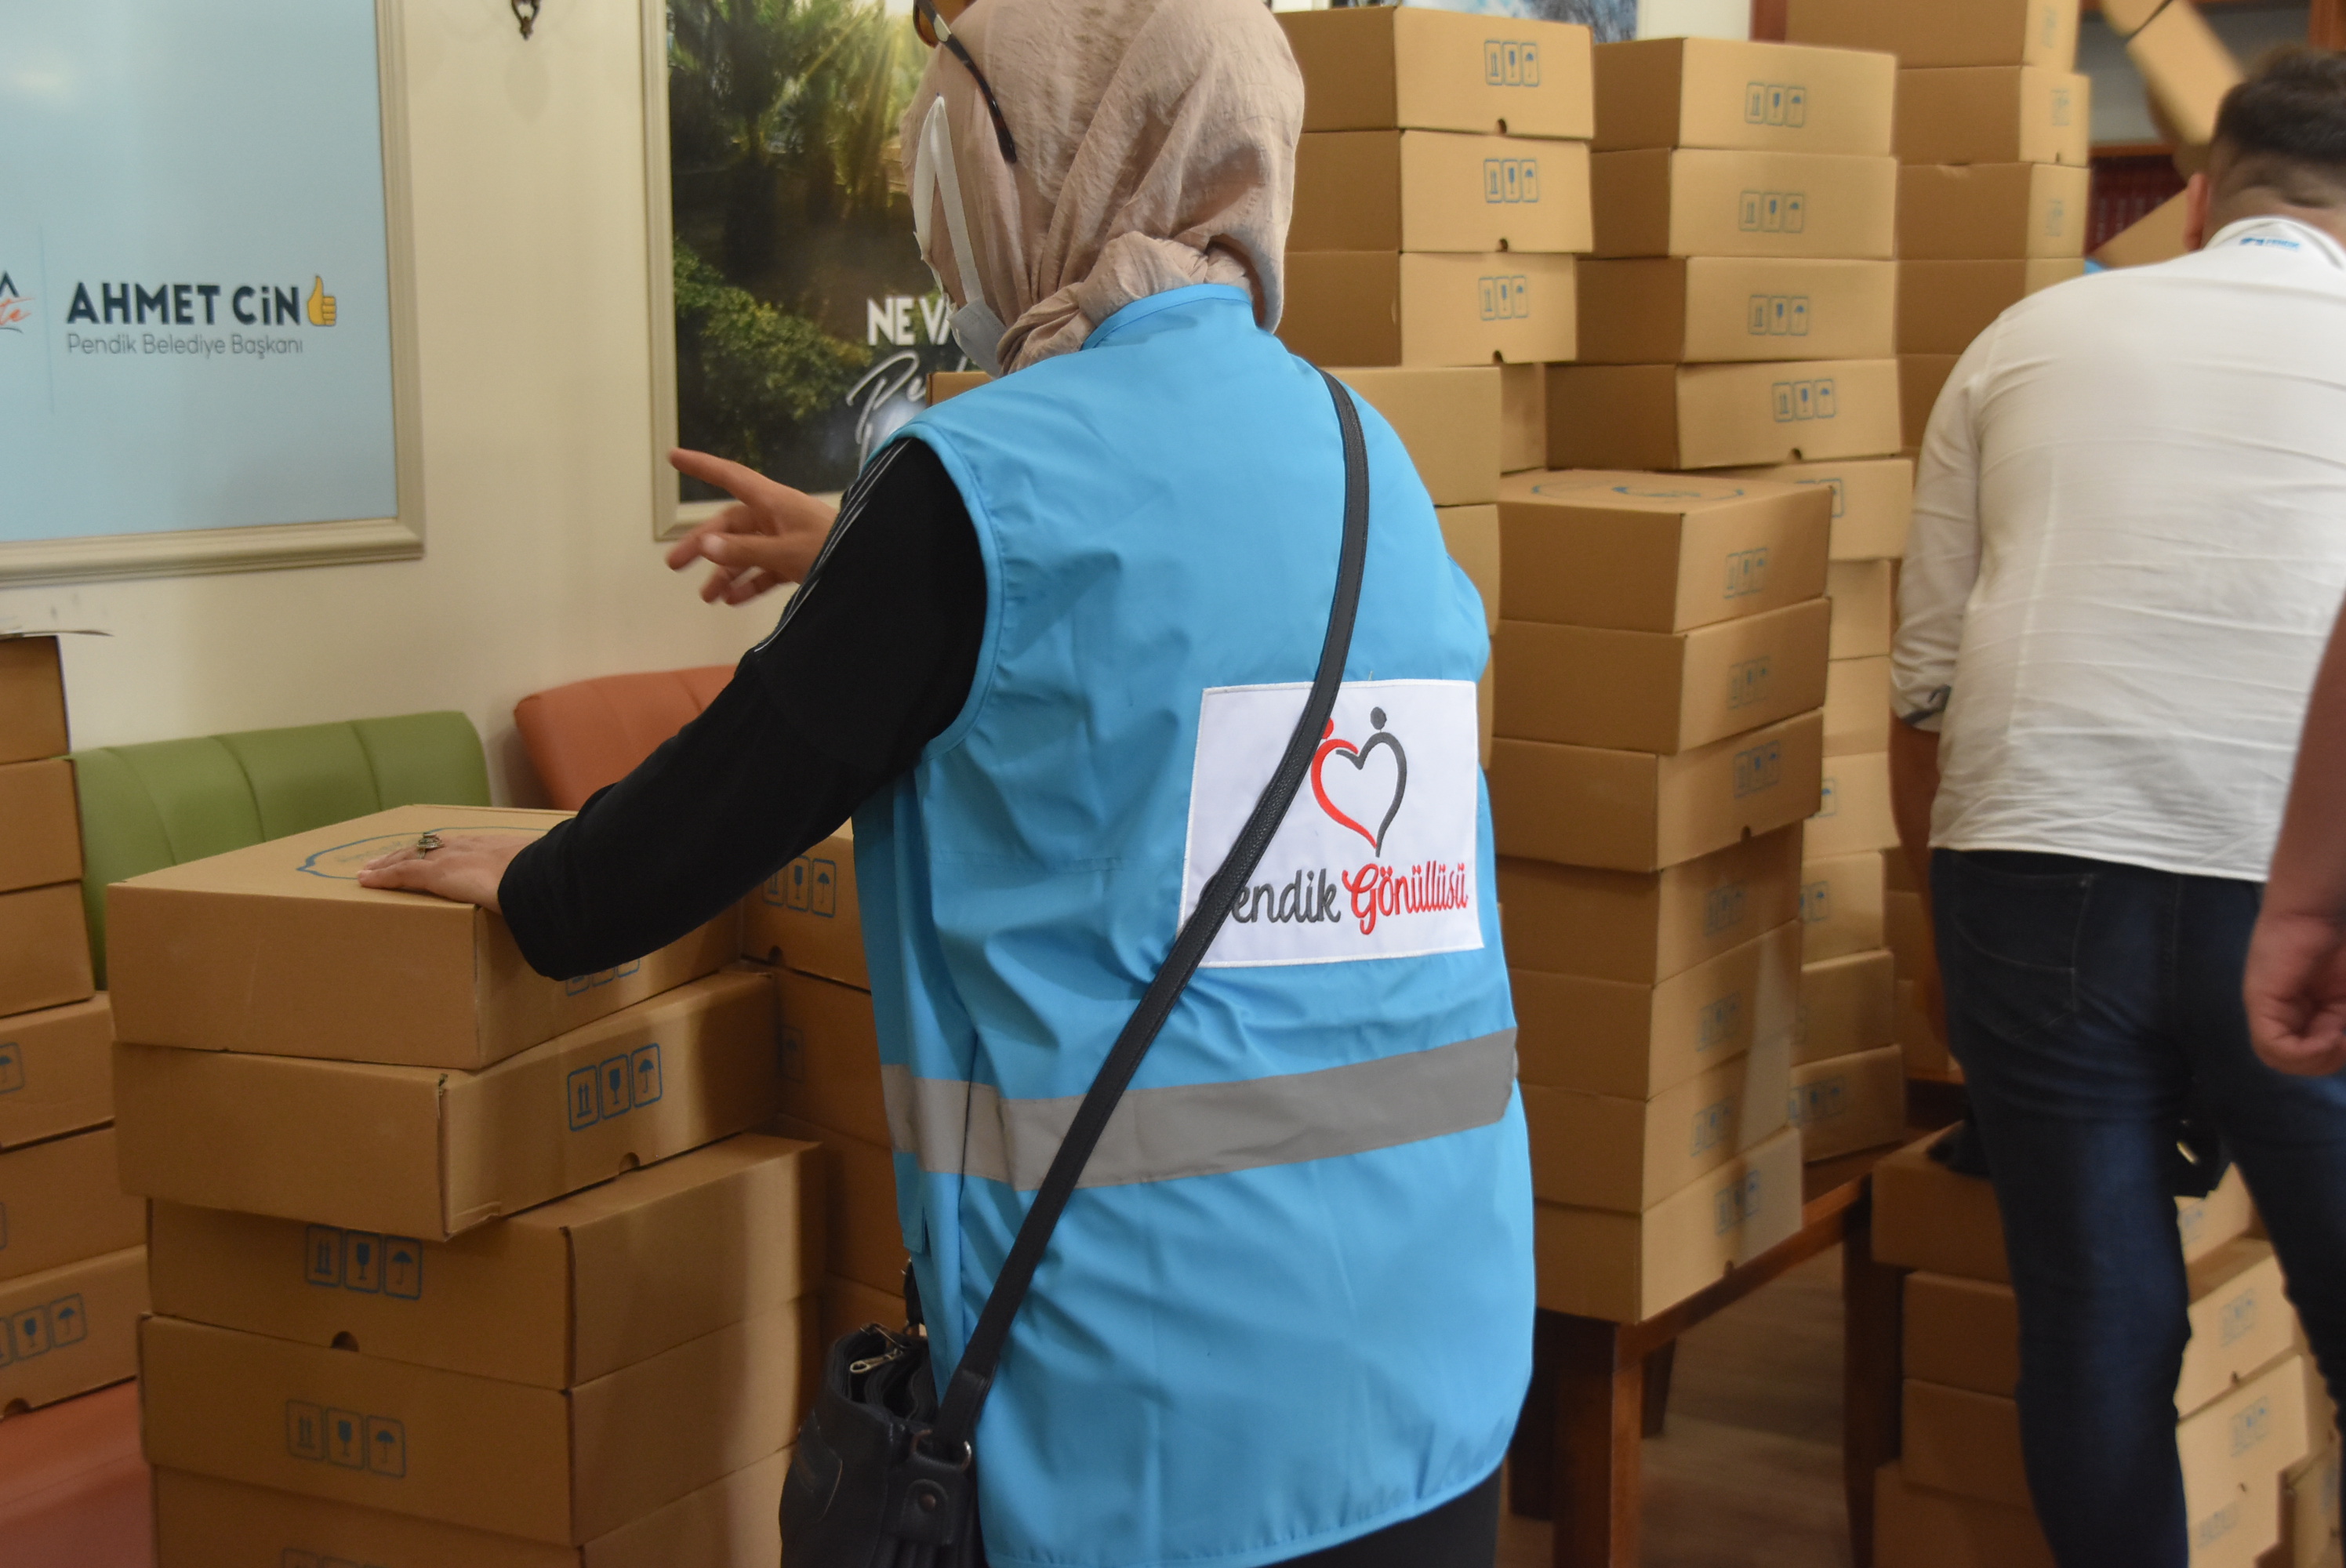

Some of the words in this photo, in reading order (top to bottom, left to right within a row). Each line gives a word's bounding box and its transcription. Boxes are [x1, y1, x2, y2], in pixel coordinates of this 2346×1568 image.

[67, 281, 220, 325] AHMET
[67, 332, 137, 354] Pendik
[142, 332, 226, 359] Belediye
[231, 333, 303, 360] Başkanı
[1231, 868, 1342, 924] endik
[1342, 860, 1469, 935] Gönüllüsü
